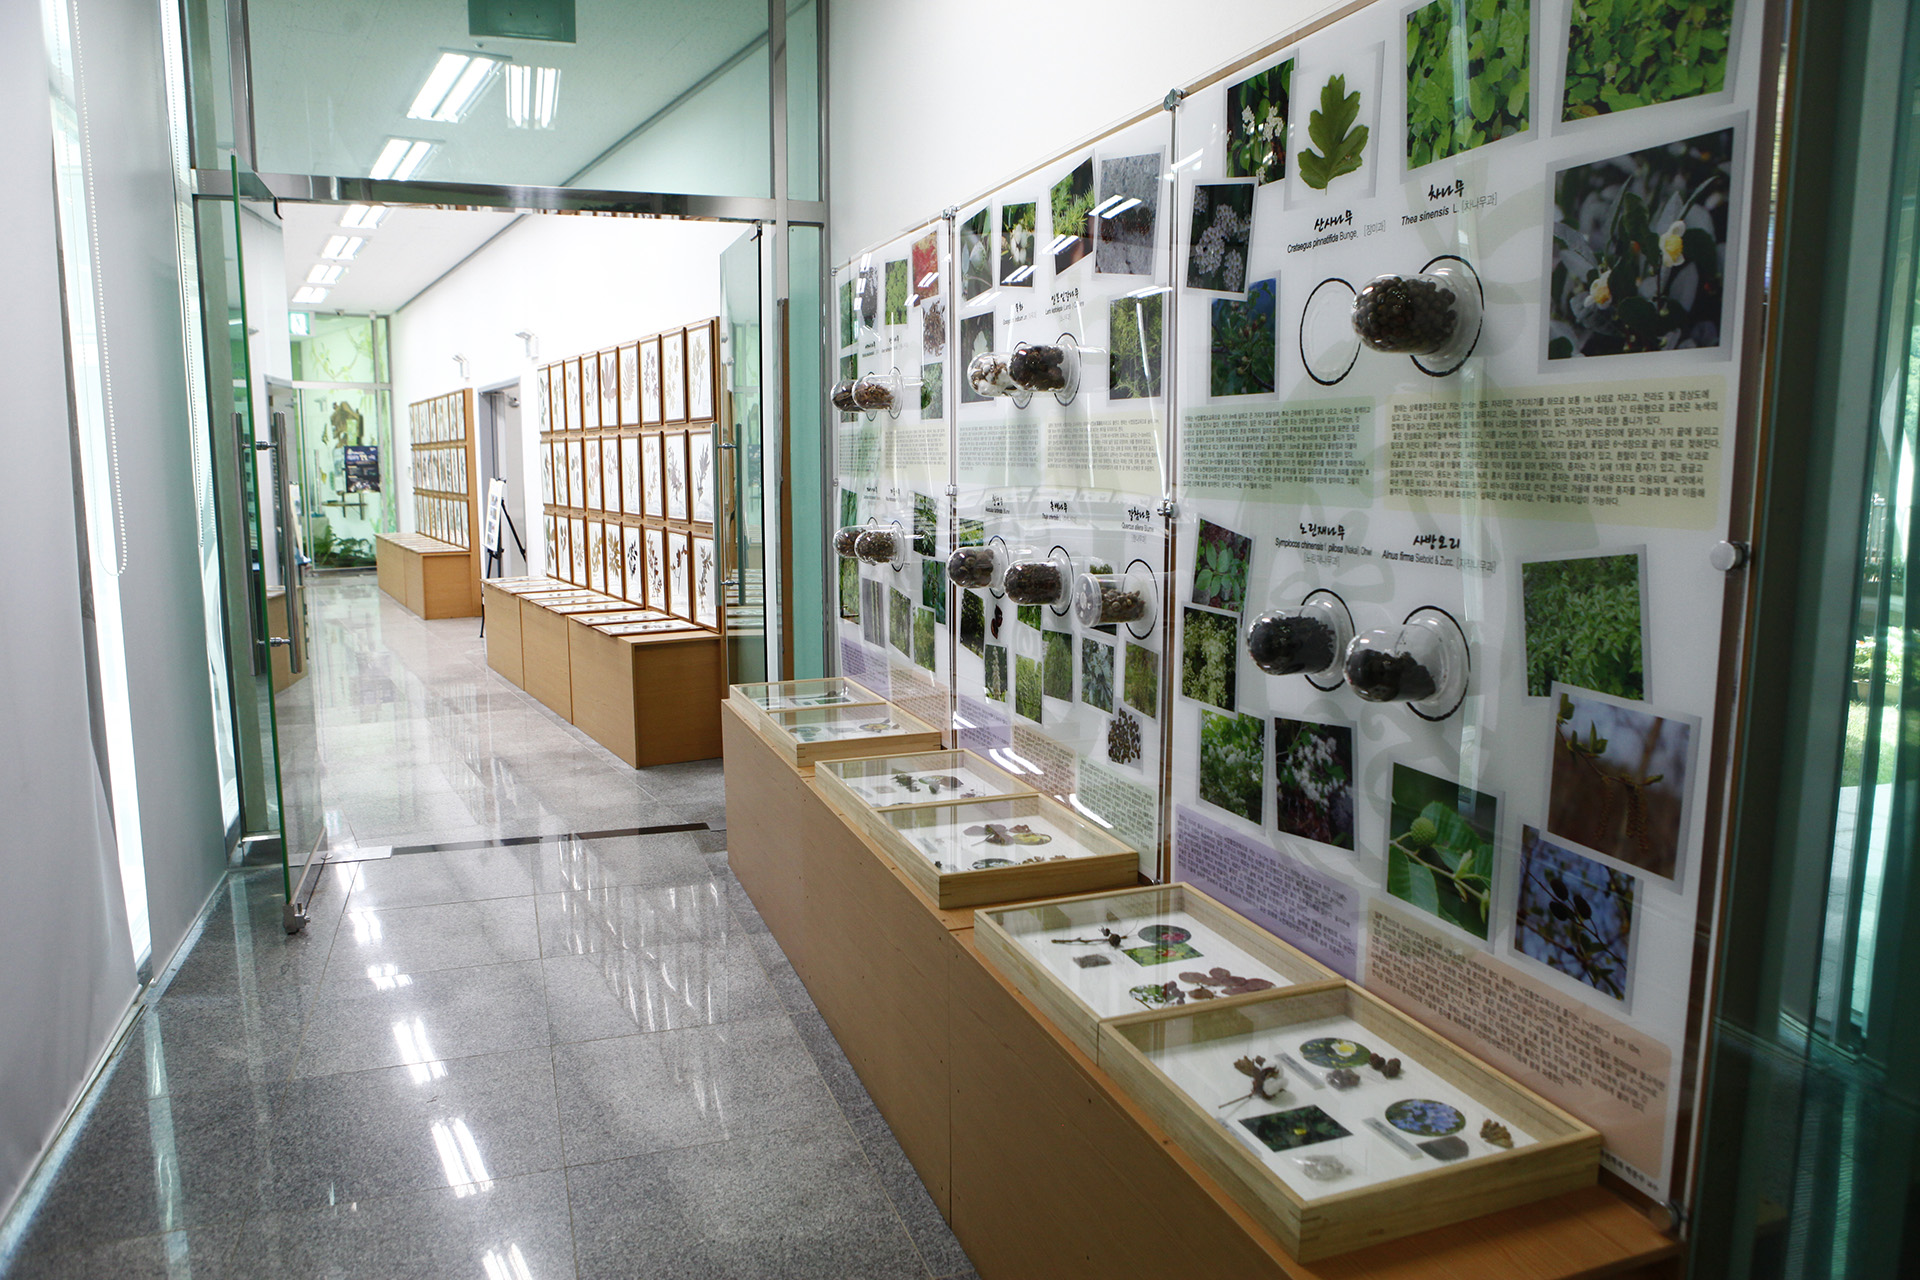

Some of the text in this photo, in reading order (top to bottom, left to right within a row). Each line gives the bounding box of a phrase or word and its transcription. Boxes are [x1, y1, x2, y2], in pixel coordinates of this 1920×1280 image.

[1428, 179, 1464, 201] 차나무
[1314, 209, 1353, 232] 산사나무
[1401, 213, 1418, 227] Thea
[1419, 206, 1449, 223] sinensis
[1287, 240, 1312, 253] Crataegus
[1312, 232, 1339, 249] pinnatifida
[1364, 220, 1386, 237] [장미과]
[1300, 523, 1345, 540] 노린재나무
[1413, 534, 1460, 550] 사방오리
[1382, 550, 1398, 560] Alnus
[1400, 552, 1414, 562] firma
